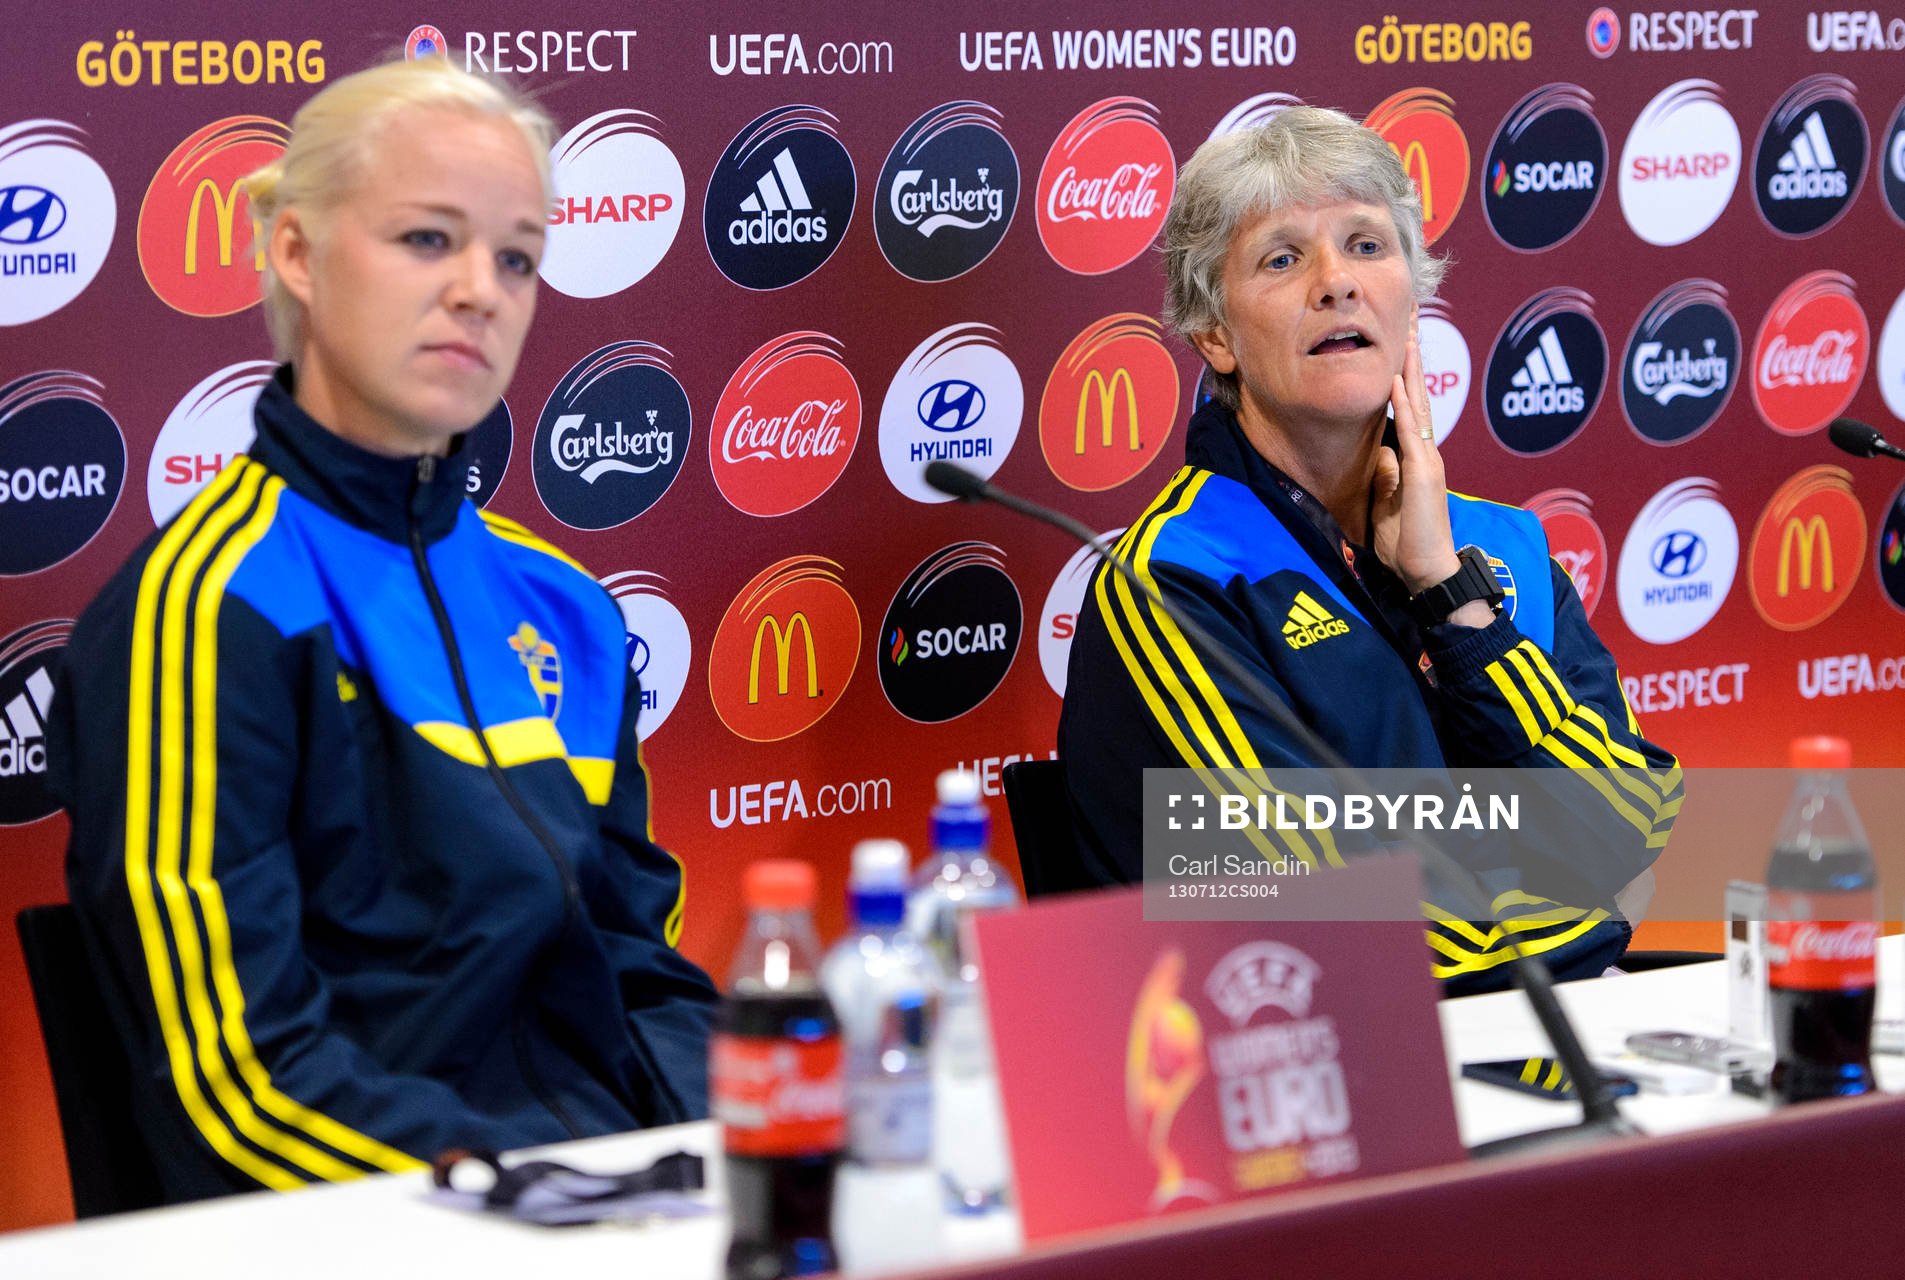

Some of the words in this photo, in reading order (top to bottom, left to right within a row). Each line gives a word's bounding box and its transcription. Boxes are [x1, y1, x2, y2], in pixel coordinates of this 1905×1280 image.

[465, 29, 637, 74] RESPECT
[959, 31, 1043, 72] UEFA
[1053, 27, 1202, 70] WOMEN'S
[1210, 25, 1297, 68] EURO
[1355, 15, 1533, 64] GÖTEBORG
[1628, 9, 1759, 52] RESPECT
[76, 30, 326, 87] GÖTEBORG
[709, 33, 893, 76] UEFA.com
[1514, 160, 1595, 193] SOCAR
[1632, 152, 1731, 182] SHARP
[1769, 170, 1848, 200] adidas
[548, 192, 673, 226] SHARP
[891, 168, 1003, 230] Carlsberg
[1047, 162, 1163, 223] Coca-Cola
[728, 209, 828, 246] adidas
[0, 252, 76, 277] UNDAI
[1632, 339, 1728, 402] Carlsberg
[1502, 383, 1585, 418] adidas
[550, 409, 674, 476] Carlsberg
[722, 399, 847, 464] Coca-Cola
[910, 437, 992, 463] HYUNDAI
[1642, 581, 1713, 607] HYUNDAI
[916, 622, 1007, 660] SOCAR
[1285, 616, 1350, 650] adidas
[1622, 663, 1750, 714] RESPECT
[709, 777, 892, 829] UEFA.com
